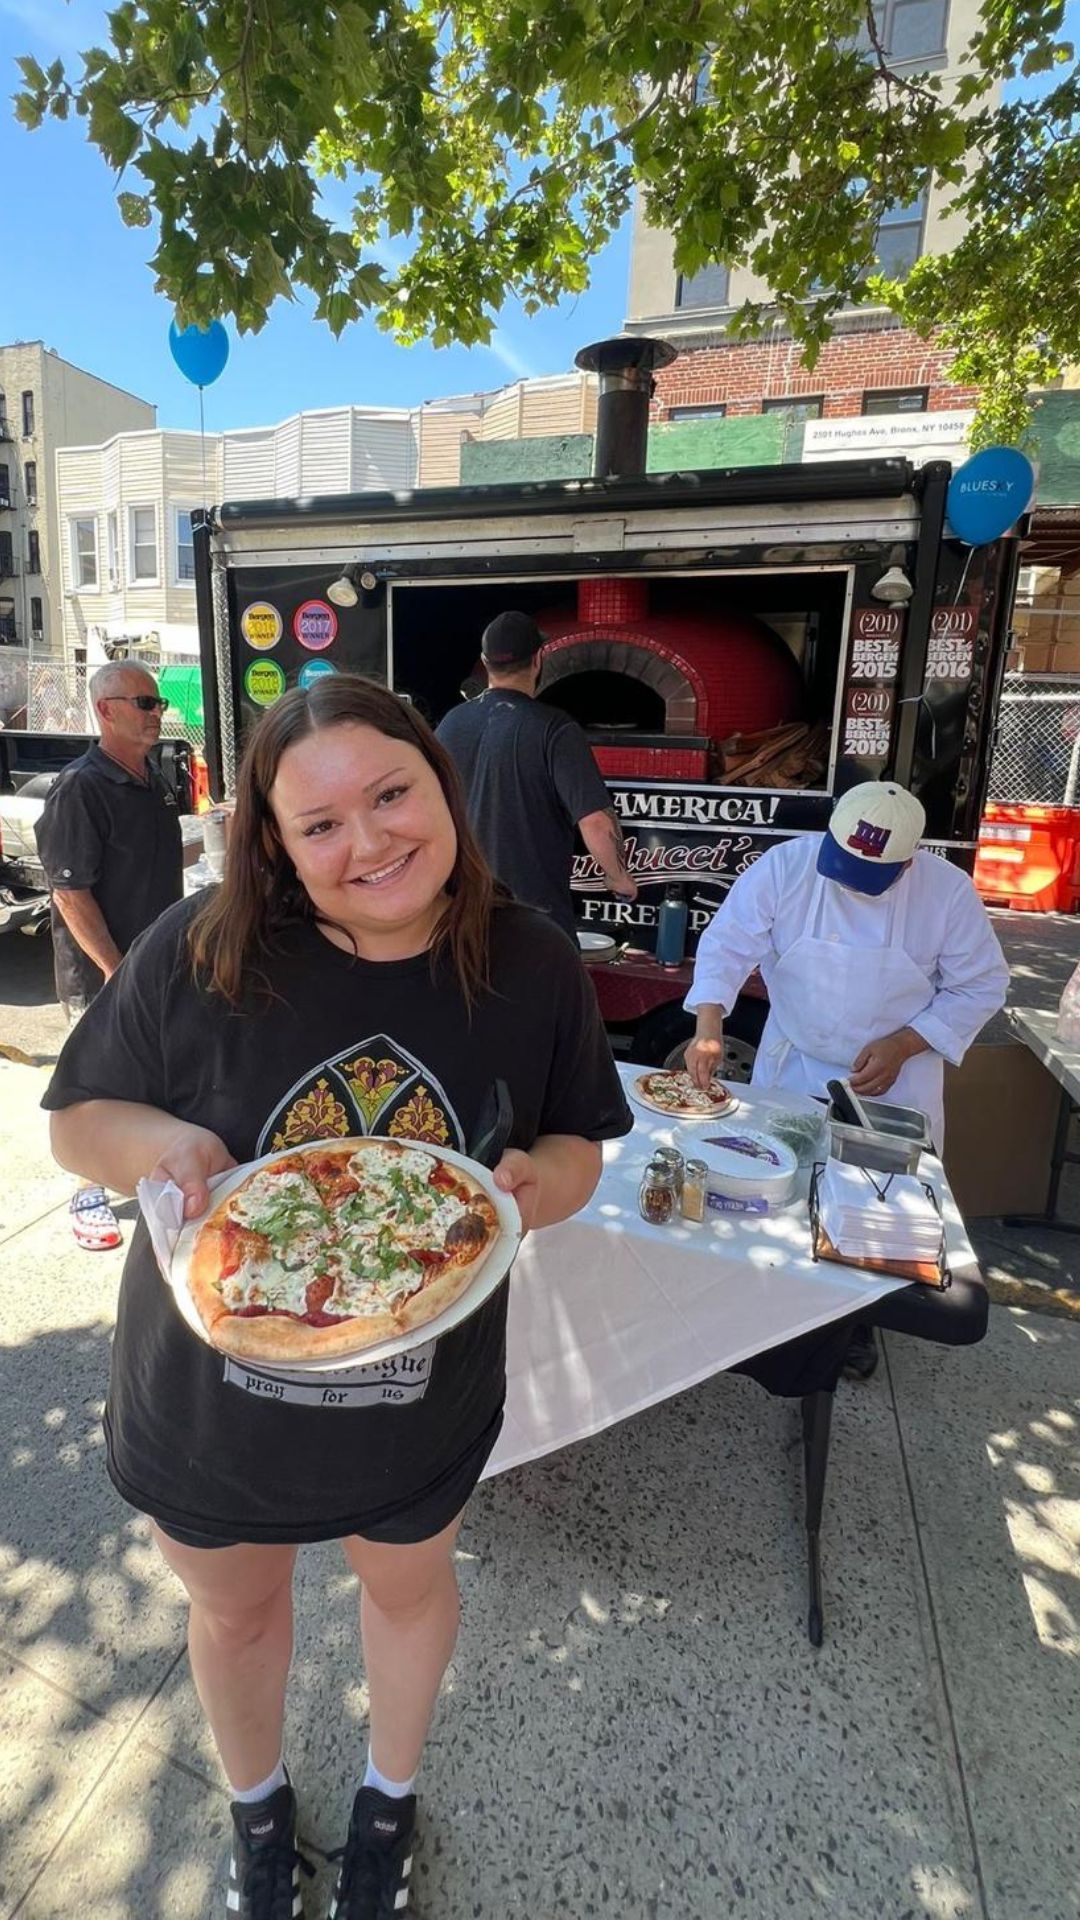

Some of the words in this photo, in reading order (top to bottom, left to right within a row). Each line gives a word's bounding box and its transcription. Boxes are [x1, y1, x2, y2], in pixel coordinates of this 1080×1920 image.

[922, 424, 936, 432] NY
[960, 480, 1014, 493] BLUESY
[301, 620, 330, 633] 2017
[859, 612, 899, 634] (201)
[931, 611, 973, 633] (201)
[853, 639, 892, 652] BEST
[928, 639, 966, 652] BEST
[852, 651, 899, 661] BERGEN
[926, 651, 972, 661] BERGEN
[851, 662, 897, 678] 2015
[924, 662, 971, 678] 2016
[852, 691, 890, 713] (201)
[846, 717, 885, 730] BEST
[844, 730, 890, 740] BERGEN
[844, 740, 890, 755] 2019
[613, 792, 781, 825] AMERICA!
[582, 899, 660, 926] FIRE
[245, 1375, 285, 1399] pray
[321, 1388, 348, 1407] for
[382, 1388, 404, 1400] us
